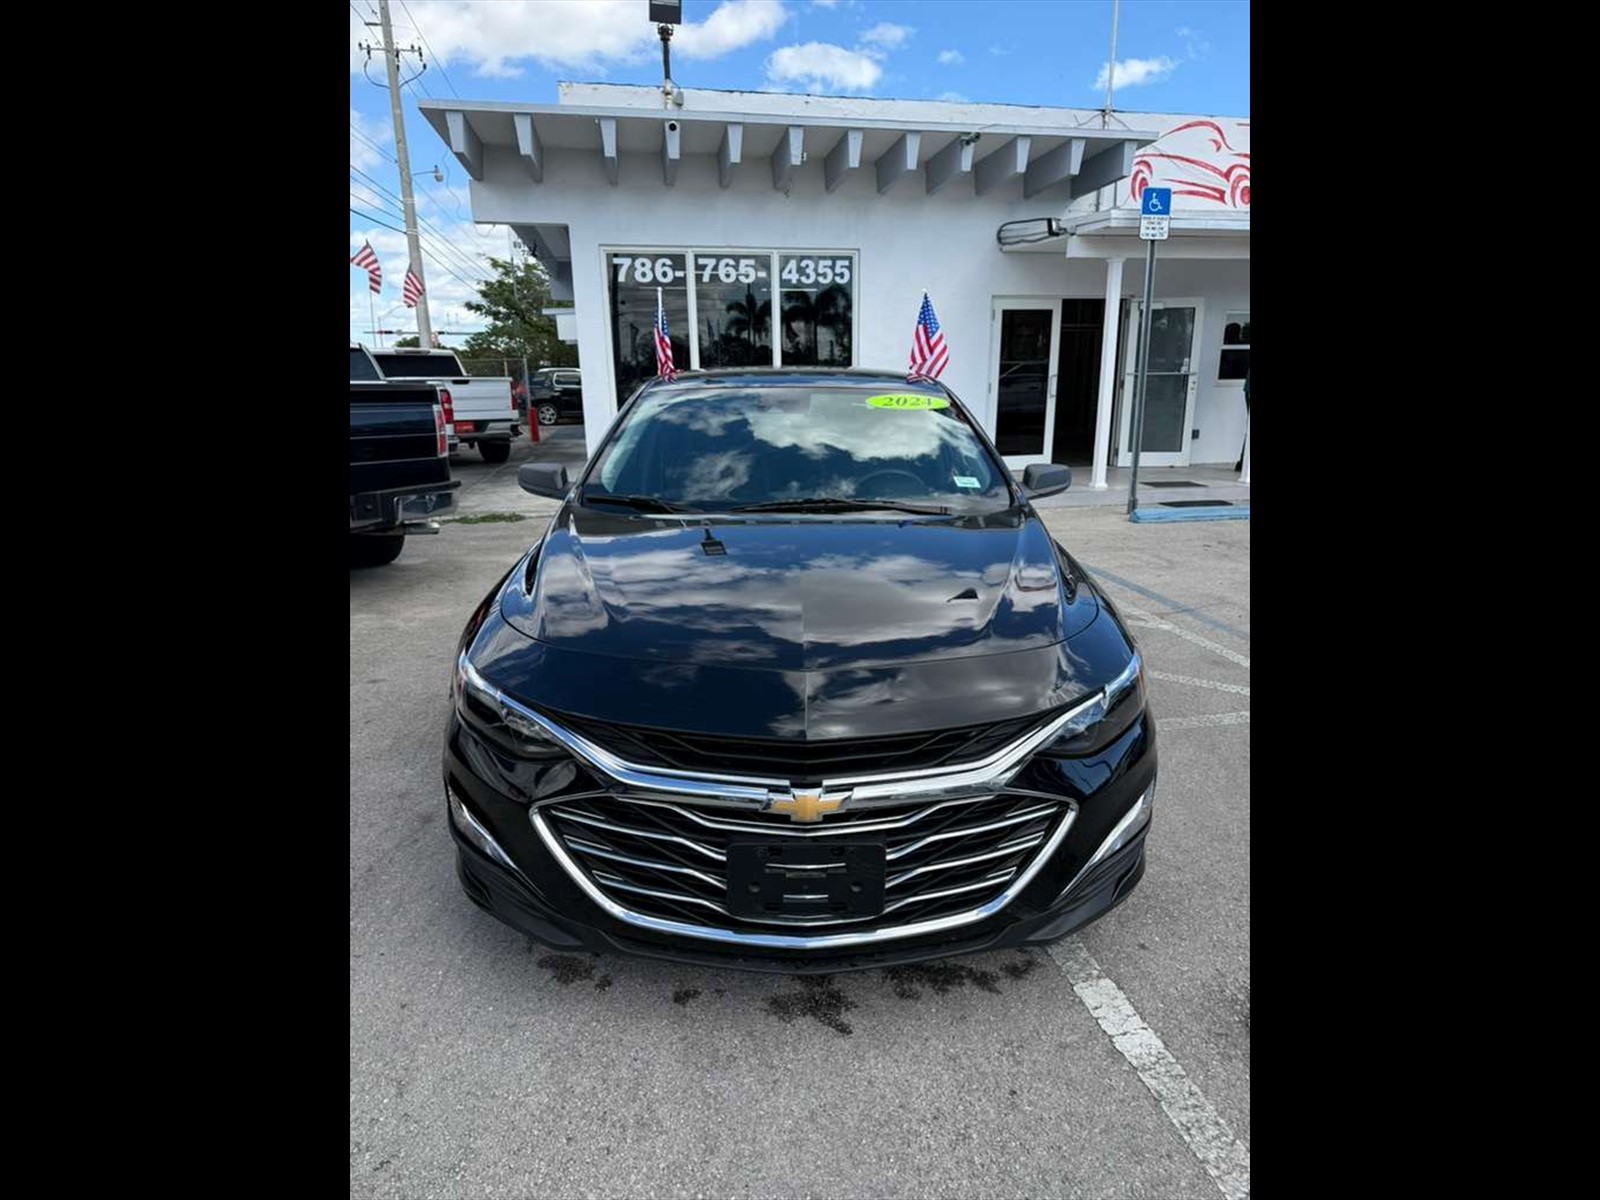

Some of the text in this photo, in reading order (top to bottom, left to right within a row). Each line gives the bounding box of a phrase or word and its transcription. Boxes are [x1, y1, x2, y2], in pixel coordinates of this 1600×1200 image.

[612, 257, 851, 285] 786- 765- 4355
[883, 396, 932, 407] 2024
